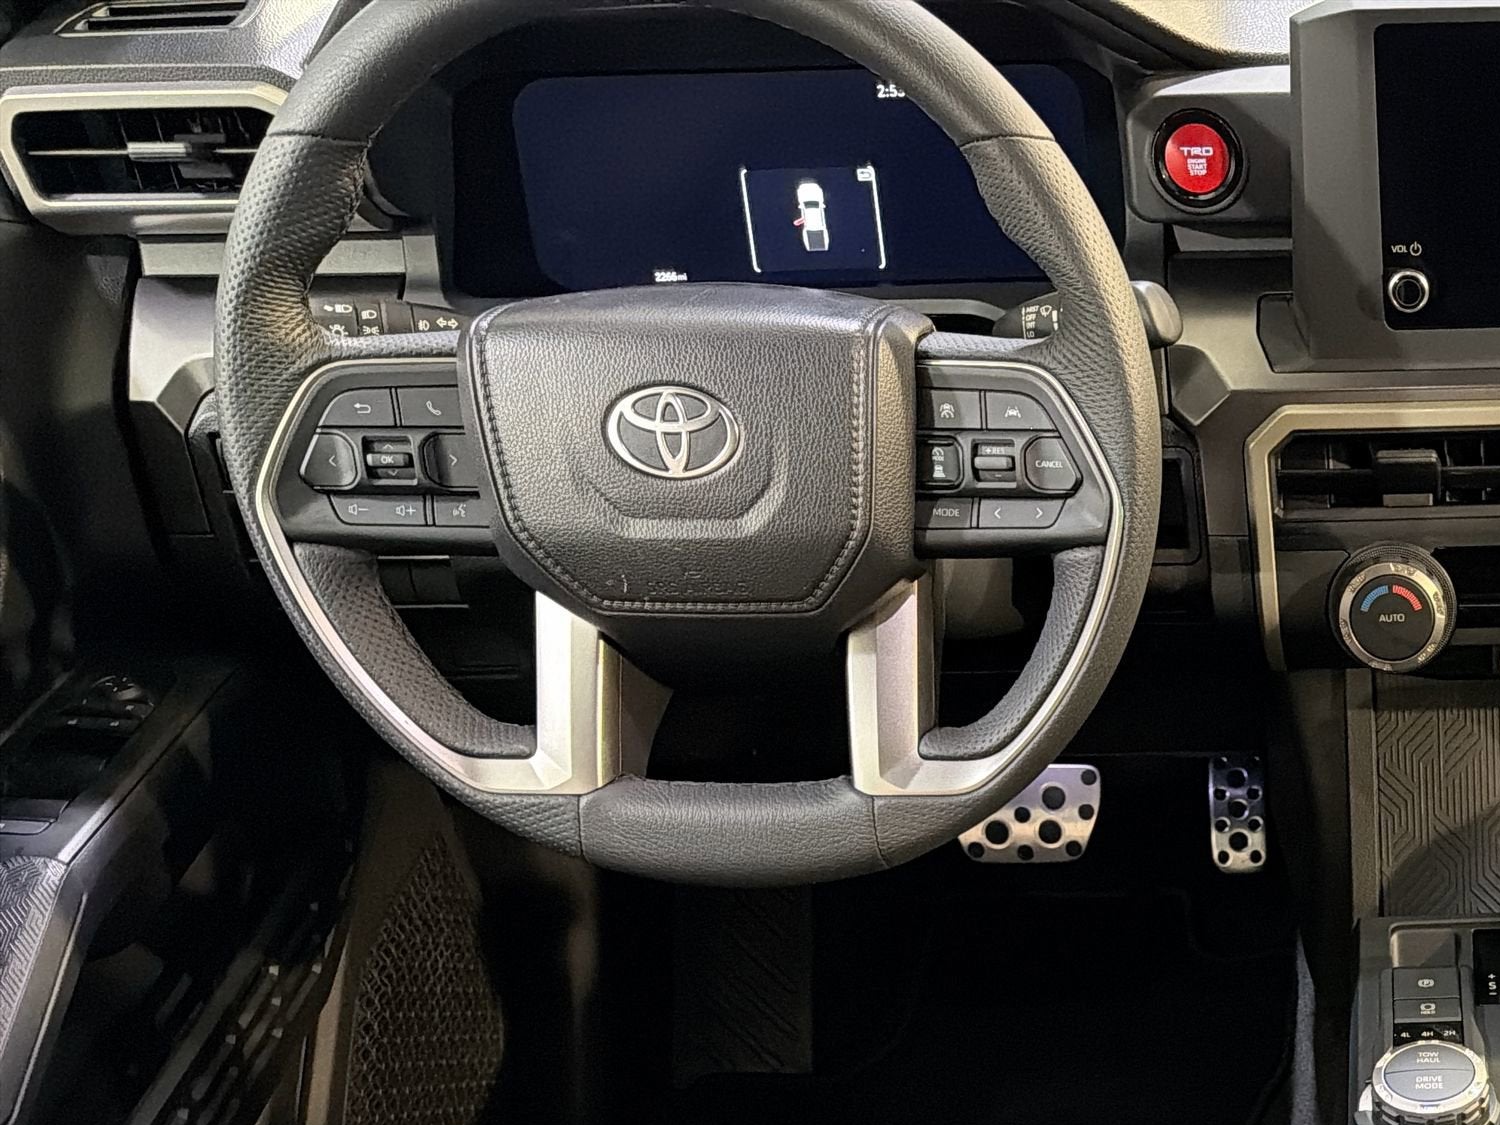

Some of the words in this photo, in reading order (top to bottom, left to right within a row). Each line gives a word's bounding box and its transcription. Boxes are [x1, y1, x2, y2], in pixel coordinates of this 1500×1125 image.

[1179, 146, 1214, 156] TRD
[1391, 244, 1408, 253] VOL
[381, 456, 395, 464] OK
[1035, 459, 1064, 469] CANCEL
[932, 508, 961, 518] MODE
[1379, 613, 1405, 623] AUTO
[1488, 981, 1497, 990] S
[1415, 1075, 1443, 1083] DRIVE
